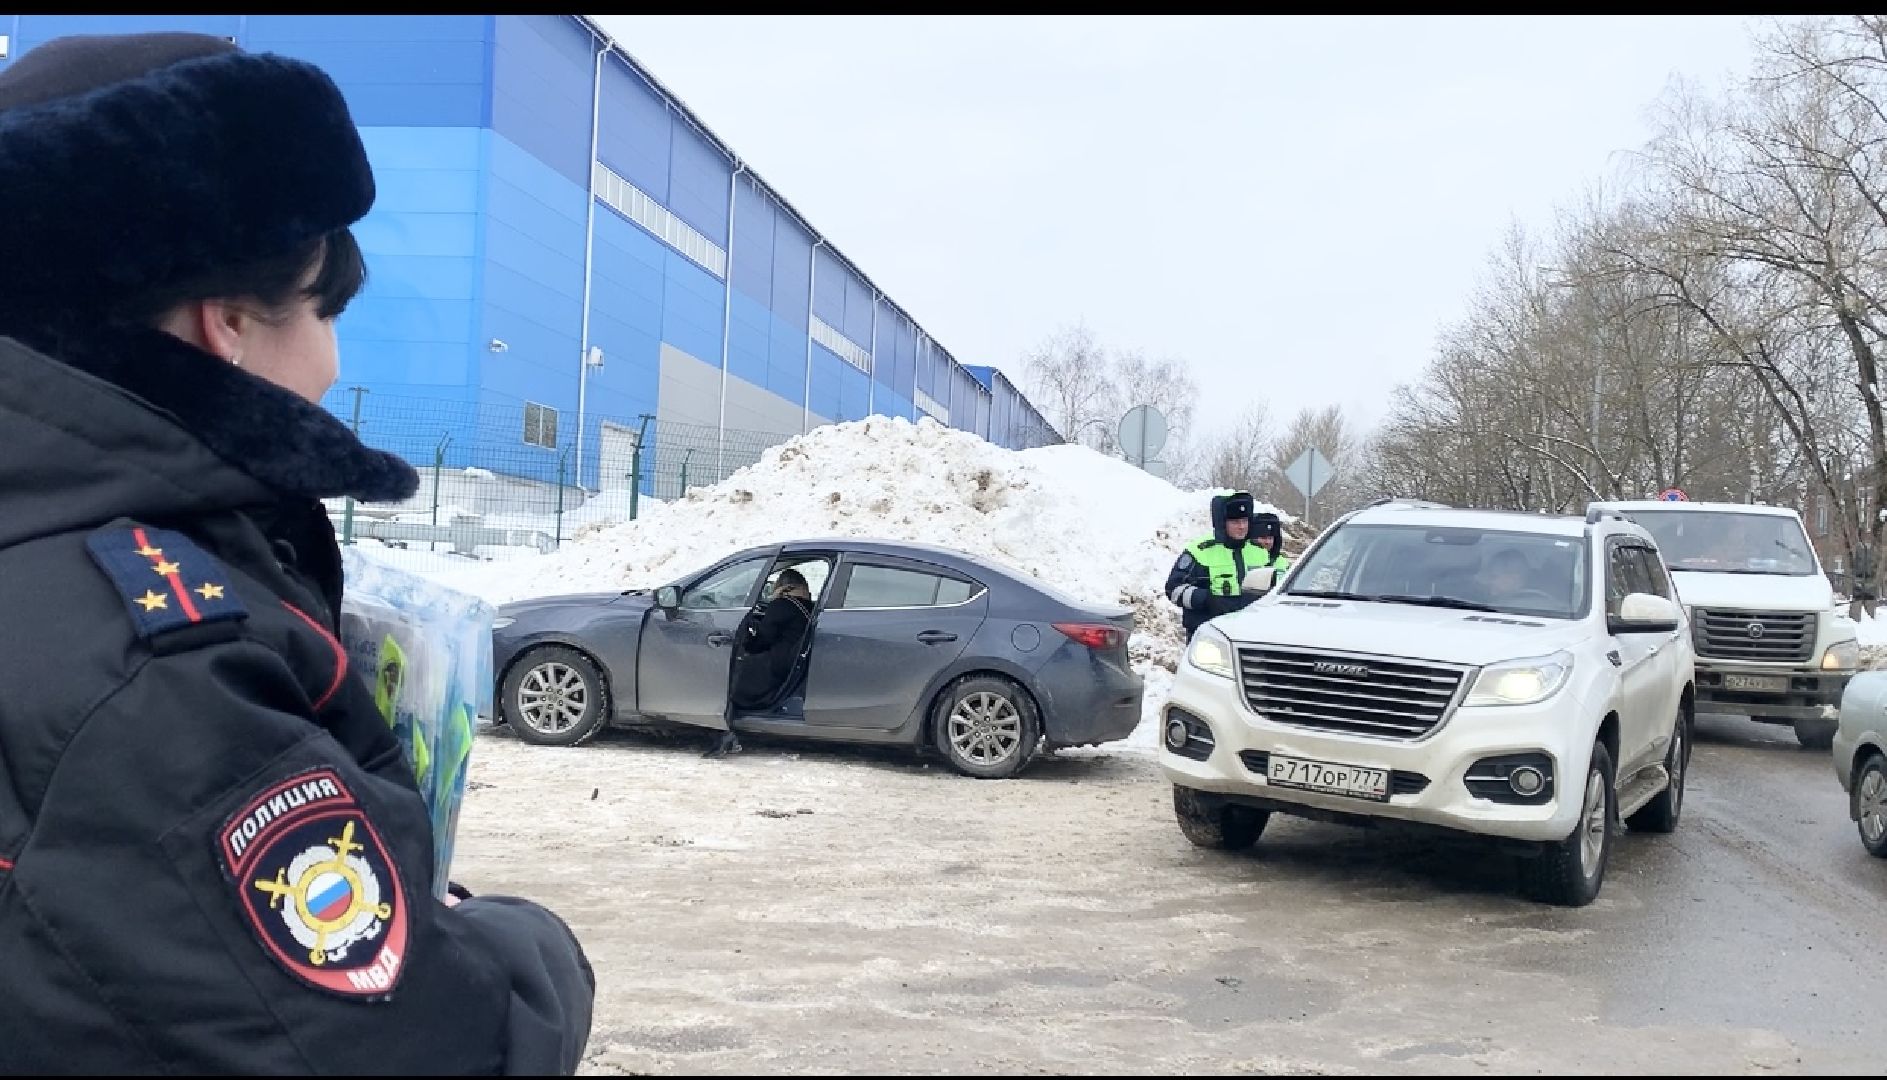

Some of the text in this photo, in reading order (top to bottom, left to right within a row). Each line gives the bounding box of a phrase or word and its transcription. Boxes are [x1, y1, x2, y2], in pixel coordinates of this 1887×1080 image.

[1273, 760, 1382, 787] Р717ОР 777
[230, 778, 338, 857] ПОЛИЦИЯ
[346, 945, 399, 991] МВД
